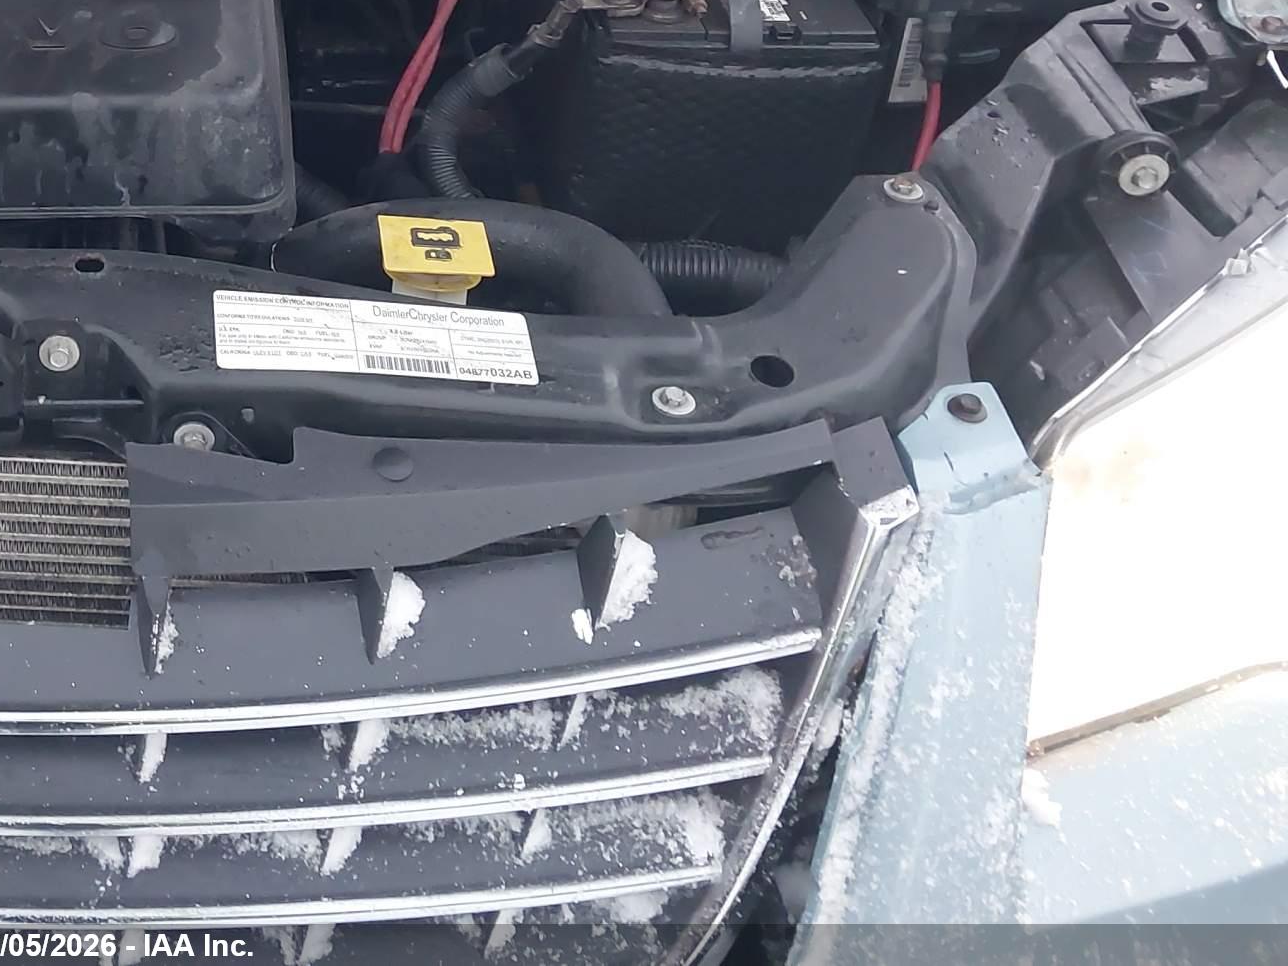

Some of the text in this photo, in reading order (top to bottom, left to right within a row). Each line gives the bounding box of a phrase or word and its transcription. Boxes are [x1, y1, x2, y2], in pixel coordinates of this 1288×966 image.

[216, 294, 244, 302] VEHICLE
[372, 305, 505, 327] DaimlerChrysler Corporation
[459, 366, 533, 380] 04877032AB
